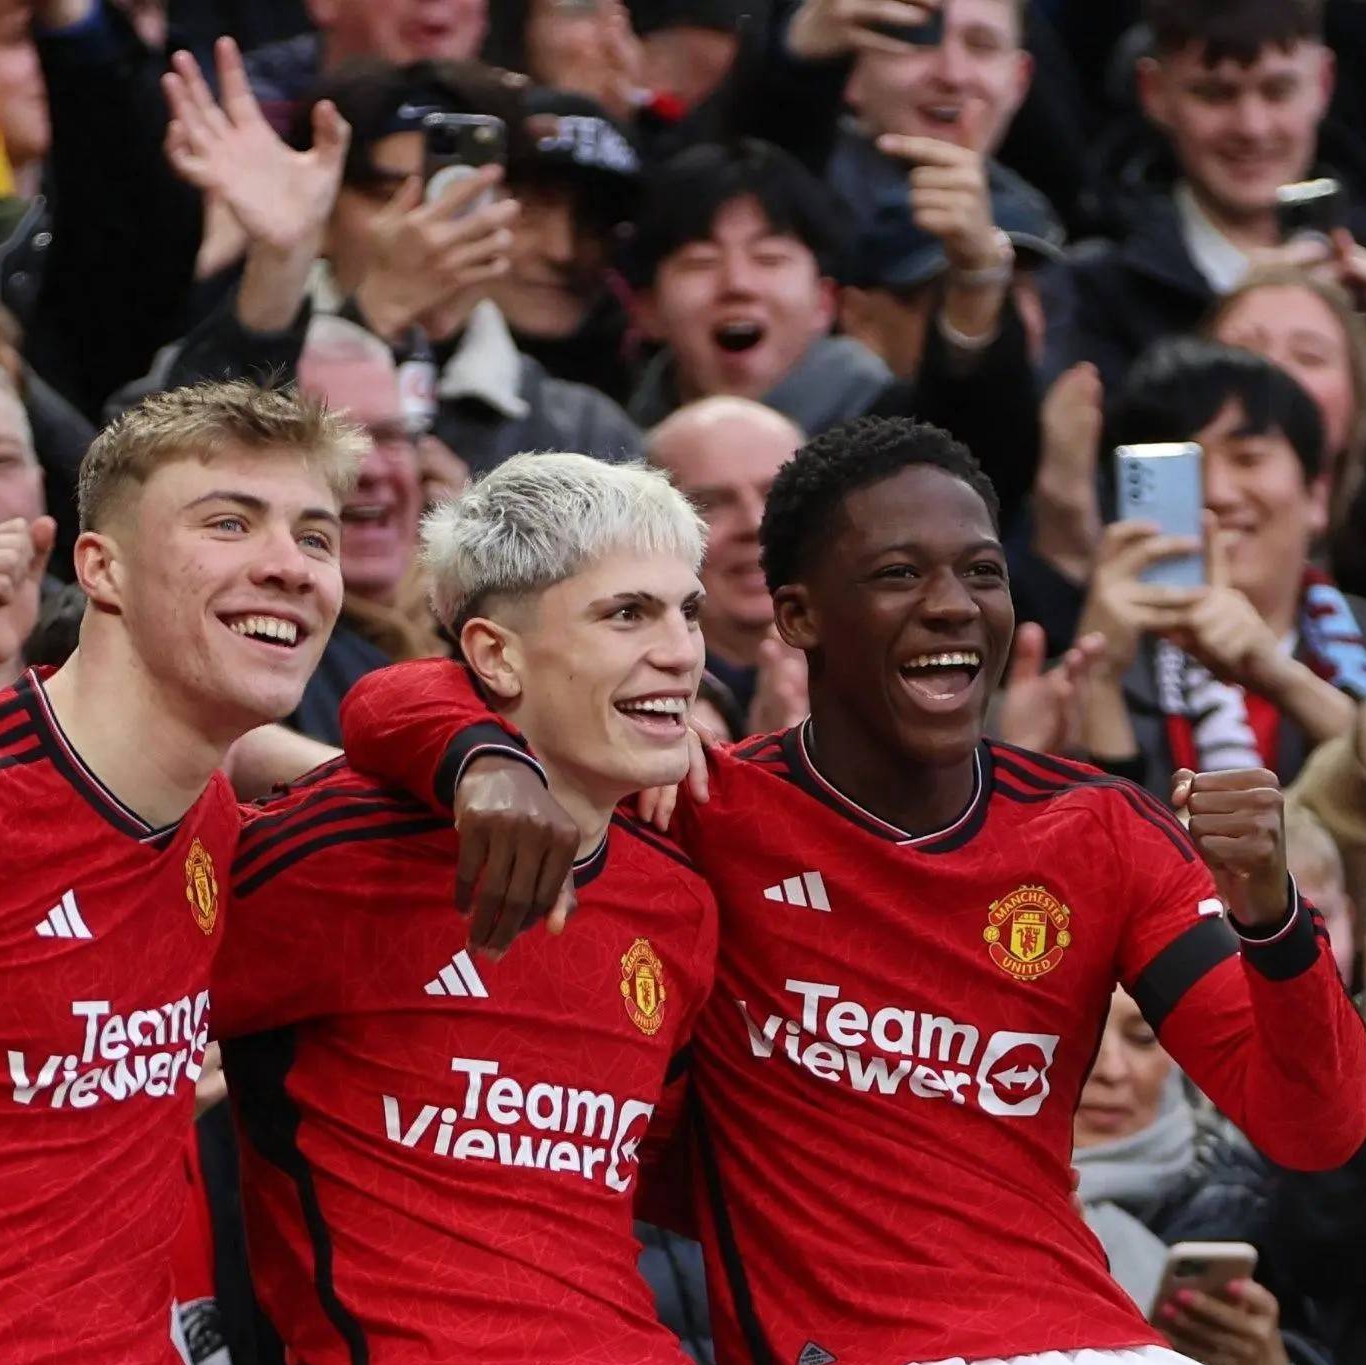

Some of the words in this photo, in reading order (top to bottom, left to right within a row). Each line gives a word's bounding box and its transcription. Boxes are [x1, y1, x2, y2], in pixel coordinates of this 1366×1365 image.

[993, 892, 1065, 924] MANCHESTER
[1001, 956, 1052, 975] UNITED
[71, 995, 193, 1064] Team
[736, 999, 973, 1106] Viewer
[784, 977, 980, 1067] Team
[6, 1047, 188, 1110] Viewer
[450, 1056, 616, 1141] Team
[382, 1093, 607, 1181] Viewer
